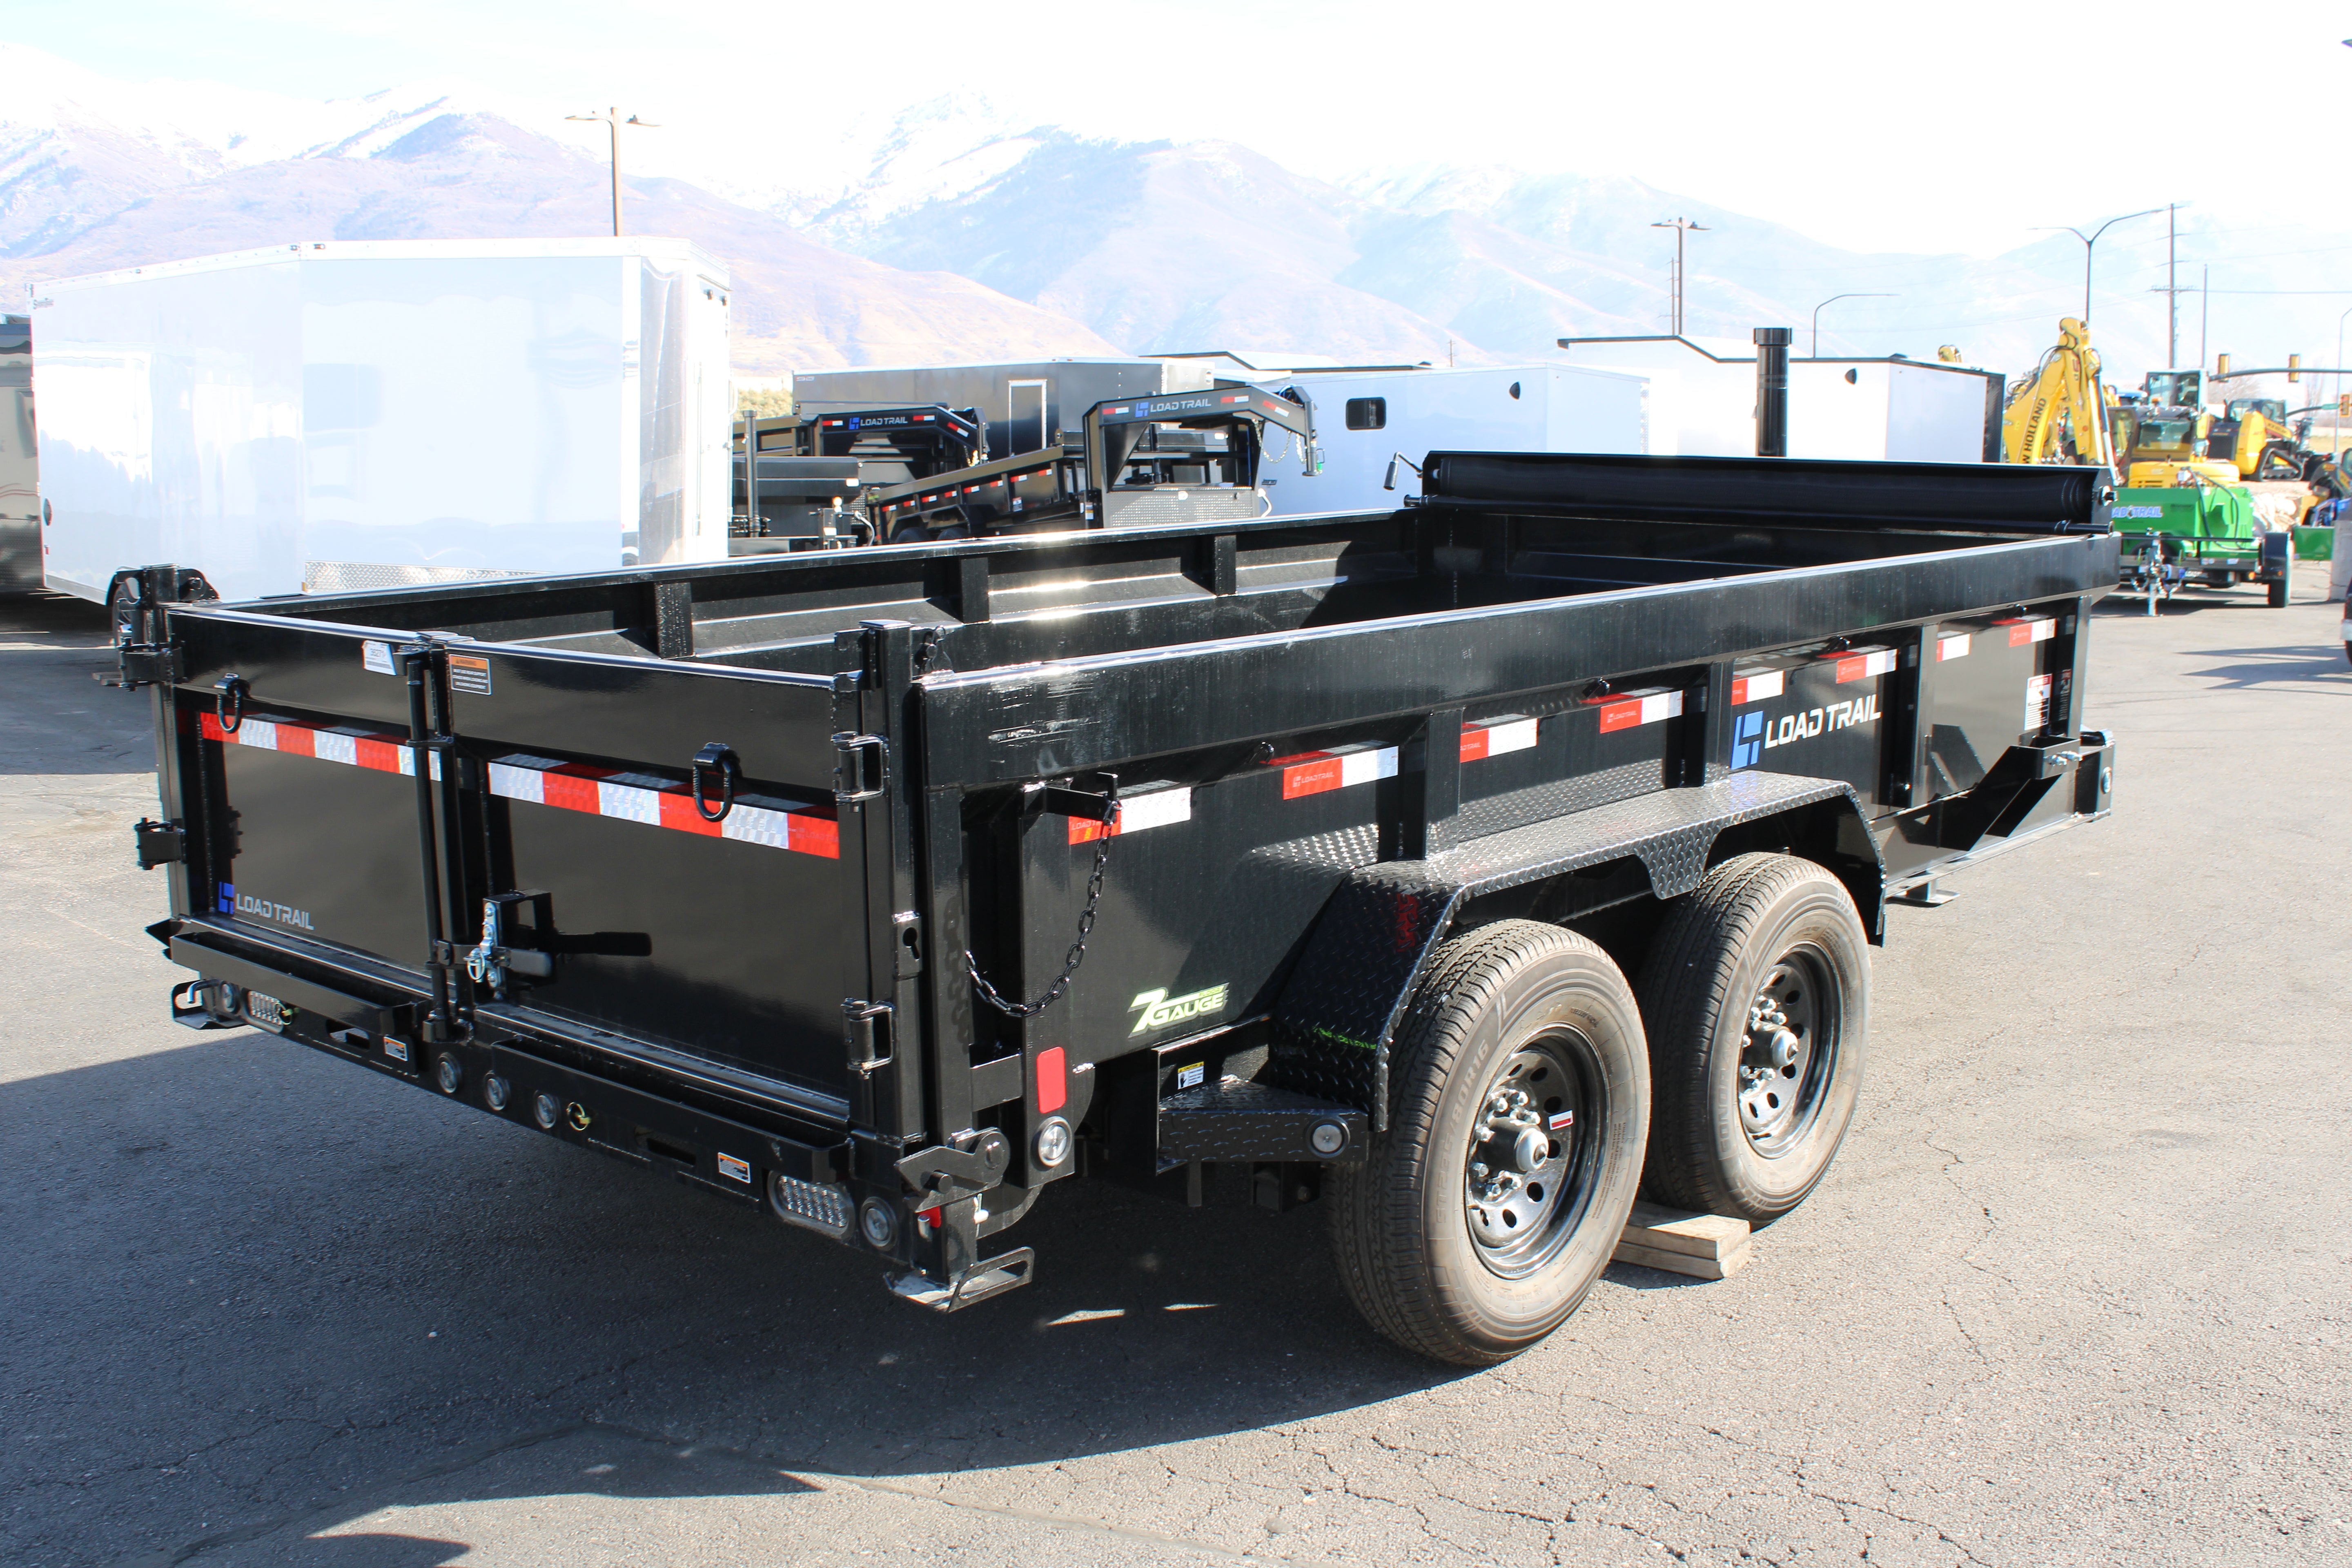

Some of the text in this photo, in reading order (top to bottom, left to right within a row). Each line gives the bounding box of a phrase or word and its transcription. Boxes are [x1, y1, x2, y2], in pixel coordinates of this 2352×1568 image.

[1150, 399, 1212, 412] LOAD TRAIL
[860, 416, 908, 426] LOAD TRAIL
[2023, 398, 2046, 451] HOLLAND
[2133, 506, 2163, 518] TRAIL
[1764, 693, 1883, 750] LOAD TRAIL
[1301, 771, 1335, 784] LOAD TRAIL
[1071, 820, 1092, 831] LOAD
[236, 893, 315, 931] LOAD TRAIL
[1129, 988, 1225, 1033] 7 GAUGE
